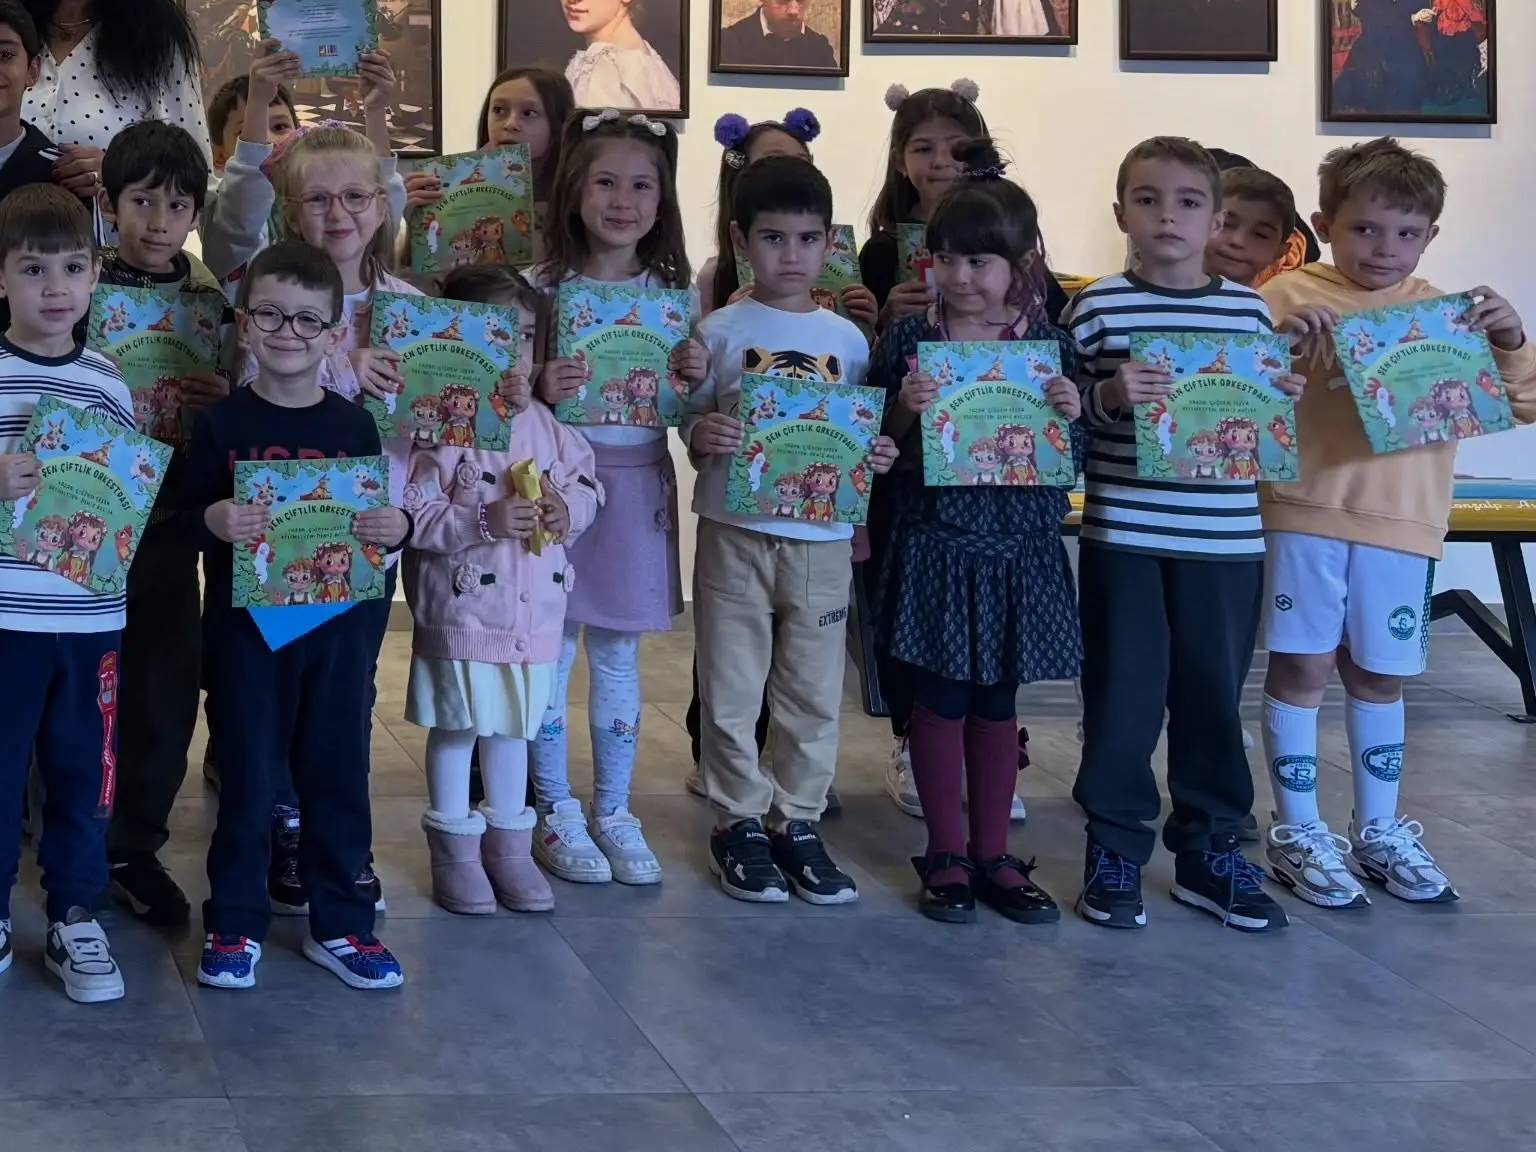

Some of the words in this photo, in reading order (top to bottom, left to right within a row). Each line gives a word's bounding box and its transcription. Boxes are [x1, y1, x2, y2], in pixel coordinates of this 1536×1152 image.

[416, 344, 448, 357] ÇİFTLİK
[450, 346, 496, 375] ORKESTRASI
[949, 397, 965, 412] ŞEN
[964, 387, 995, 402] ÇİFTLİK
[996, 387, 1045, 411] ORKESTRASI
[1184, 379, 1217, 394] ÇİFTLİK
[1220, 380, 1272, 405] ORKESTRASI
[766, 432, 782, 445] ŞEN
[783, 425, 814, 437] ÇİFTLİK
[816, 427, 858, 453] ORKESTRASI
[42, 466, 59, 479] ŞEN
[60, 463, 92, 476] ÇİFTLİK
[93, 471, 131, 511] ORKESTRASI
[284, 506, 317, 522] ÇİFTLİK
